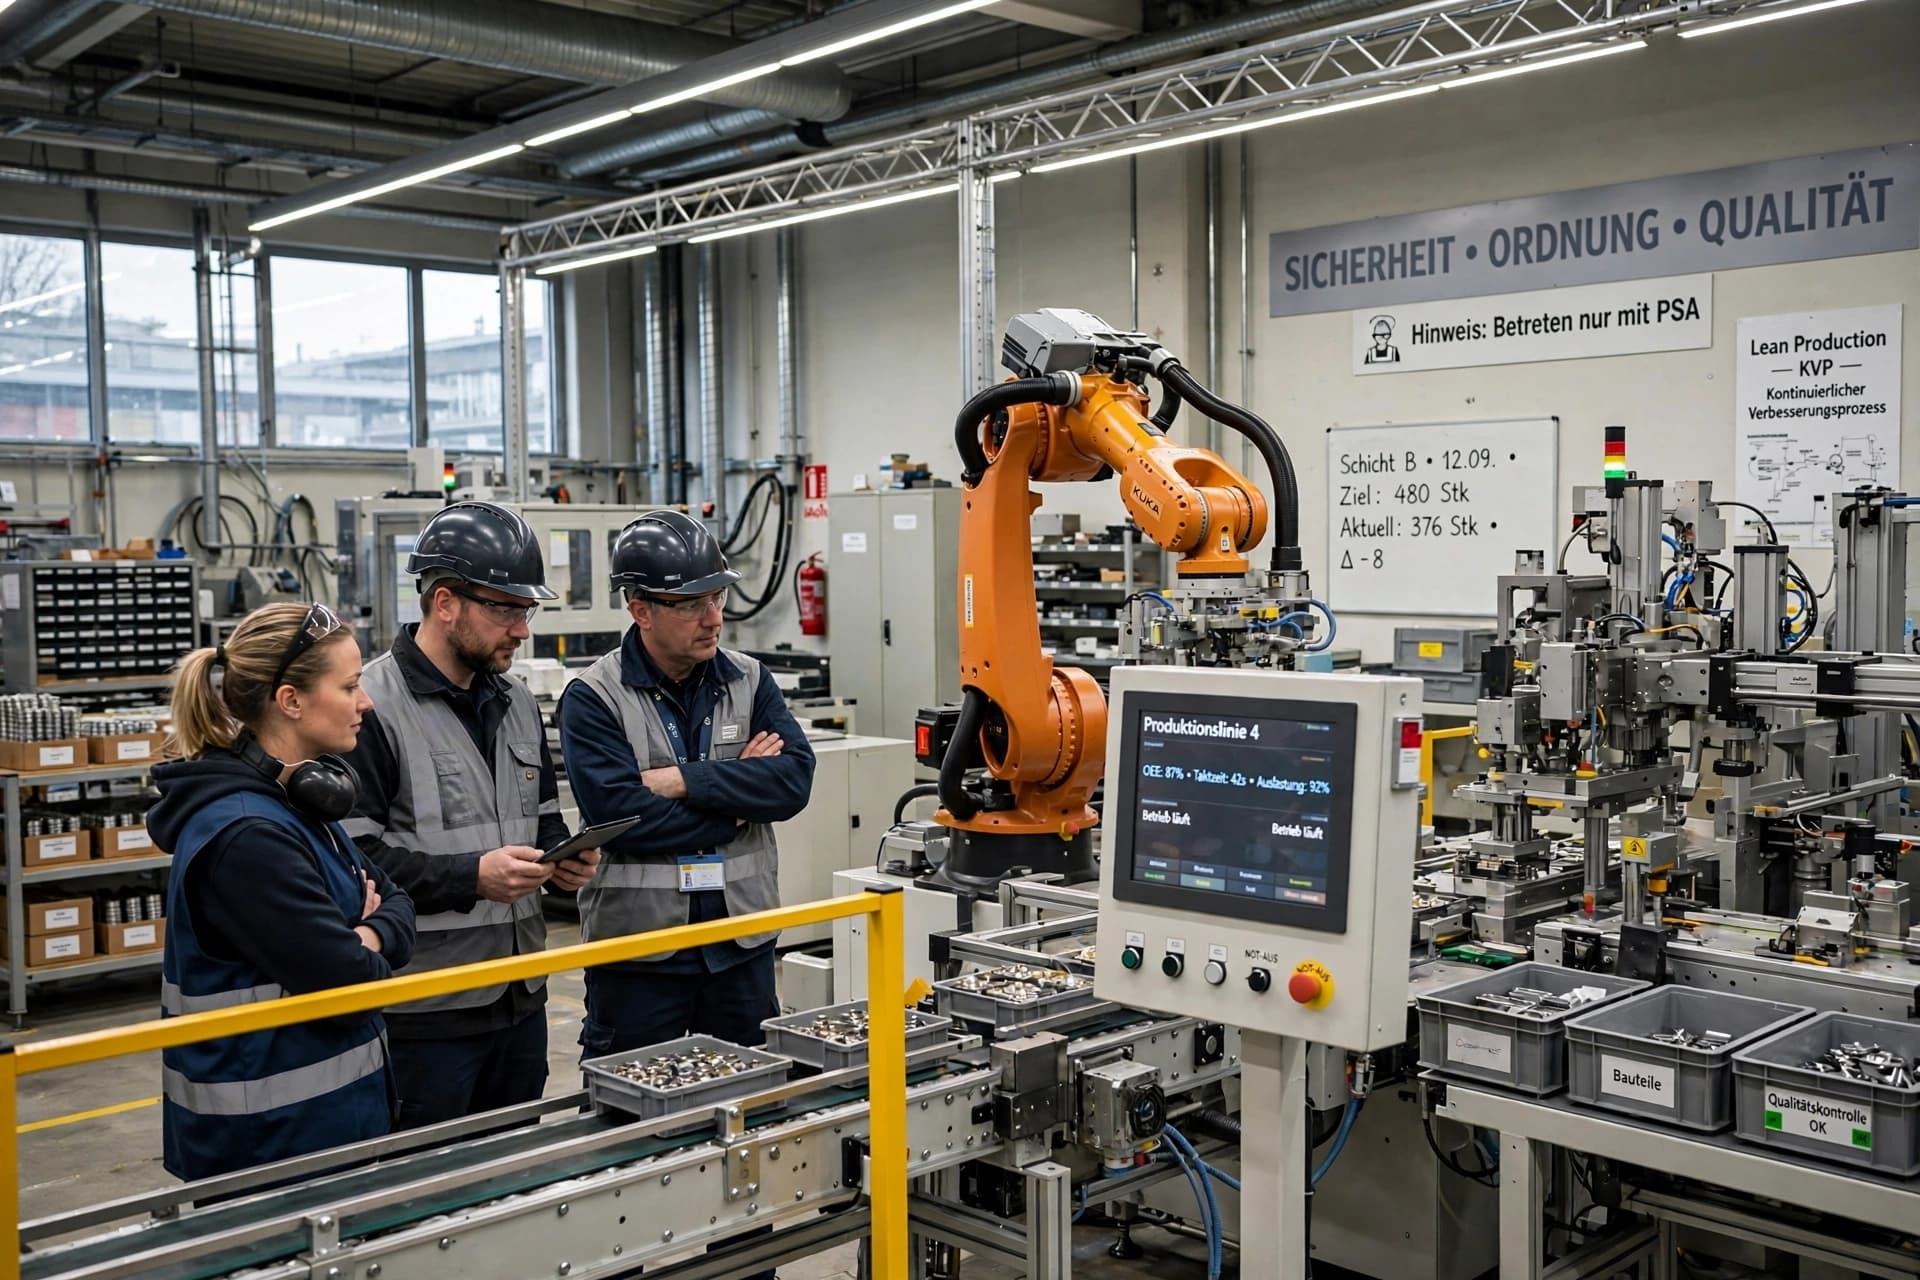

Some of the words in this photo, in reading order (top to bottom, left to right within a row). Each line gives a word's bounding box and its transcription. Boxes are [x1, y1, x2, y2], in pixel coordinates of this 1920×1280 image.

[1284, 235, 1456, 292] SICHERHEIT
[1488, 208, 1660, 268] ORDNUNG
[1699, 170, 1894, 247] QUALITÄT
[1411, 318, 1487, 345] Hinweis:
[1493, 312, 1573, 338] Betreten
[1578, 308, 1612, 331] nur
[1617, 302, 1650, 326] mit
[1656, 297, 1700, 323] PSA
[1751, 339, 1789, 356] Lean
[1794, 330, 1887, 353] Production
[1799, 358, 1834, 377] KVP
[1766, 382, 1866, 401] Kontinuierlicher
[1748, 402, 1887, 420] Verbesserungsprozess
[1340, 451, 1396, 474] Schicht
[1405, 451, 1417, 472] B
[1442, 448, 1496, 470] 12.09.
[1132, 485, 1160, 515] KUKA
[1339, 484, 1381, 506] Ziel:
[1394, 483, 1430, 504] 480
[1440, 481, 1470, 503] Stk
[1340, 515, 1401, 538] Aktuell:
[1410, 516, 1442, 537] 376
[1450, 514, 1479, 536] Stk
[1143, 716, 1248, 740] Produktionslinie
[1249, 723, 1260, 741] 4
[1142, 764, 1164, 778] OEE:
[1164, 766, 1185, 780] 87%
[1193, 768, 1229, 785] Taktzeit:
[1256, 775, 1308, 796] Auslastung:
[1308, 779, 1331, 795] 92%
[1142, 809, 1172, 825] Betrieb
[1172, 811, 1192, 827] läuft
[1271, 822, 1302, 838] Betrieb
[1303, 825, 1324, 841] läuft
[1612, 1067, 1663, 1092] Bauteile
[1767, 1092, 1868, 1126] Qualitätskontrolle
[1808, 1119, 1827, 1135] OK
